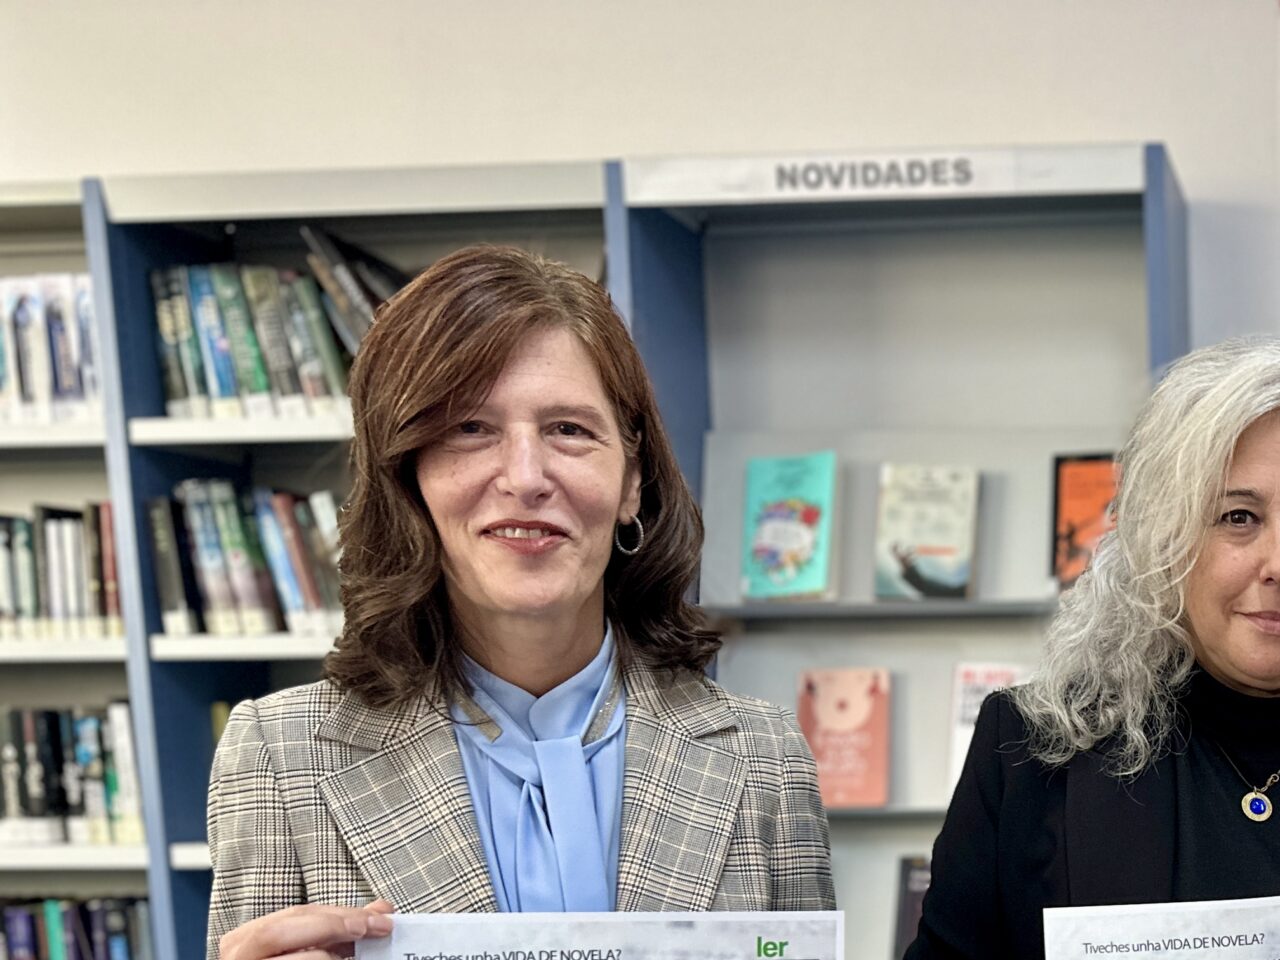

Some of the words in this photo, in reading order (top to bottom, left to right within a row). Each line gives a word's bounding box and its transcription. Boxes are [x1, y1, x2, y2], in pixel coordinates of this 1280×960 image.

[775, 158, 973, 189] NOVIDADES
[756, 936, 788, 958] ler
[1082, 941, 1130, 954] Tiveches
[1131, 939, 1161, 952] unha
[1161, 938, 1192, 951] VIDA
[1192, 936, 1209, 949] DE
[1211, 932, 1265, 948] NOVELA?
